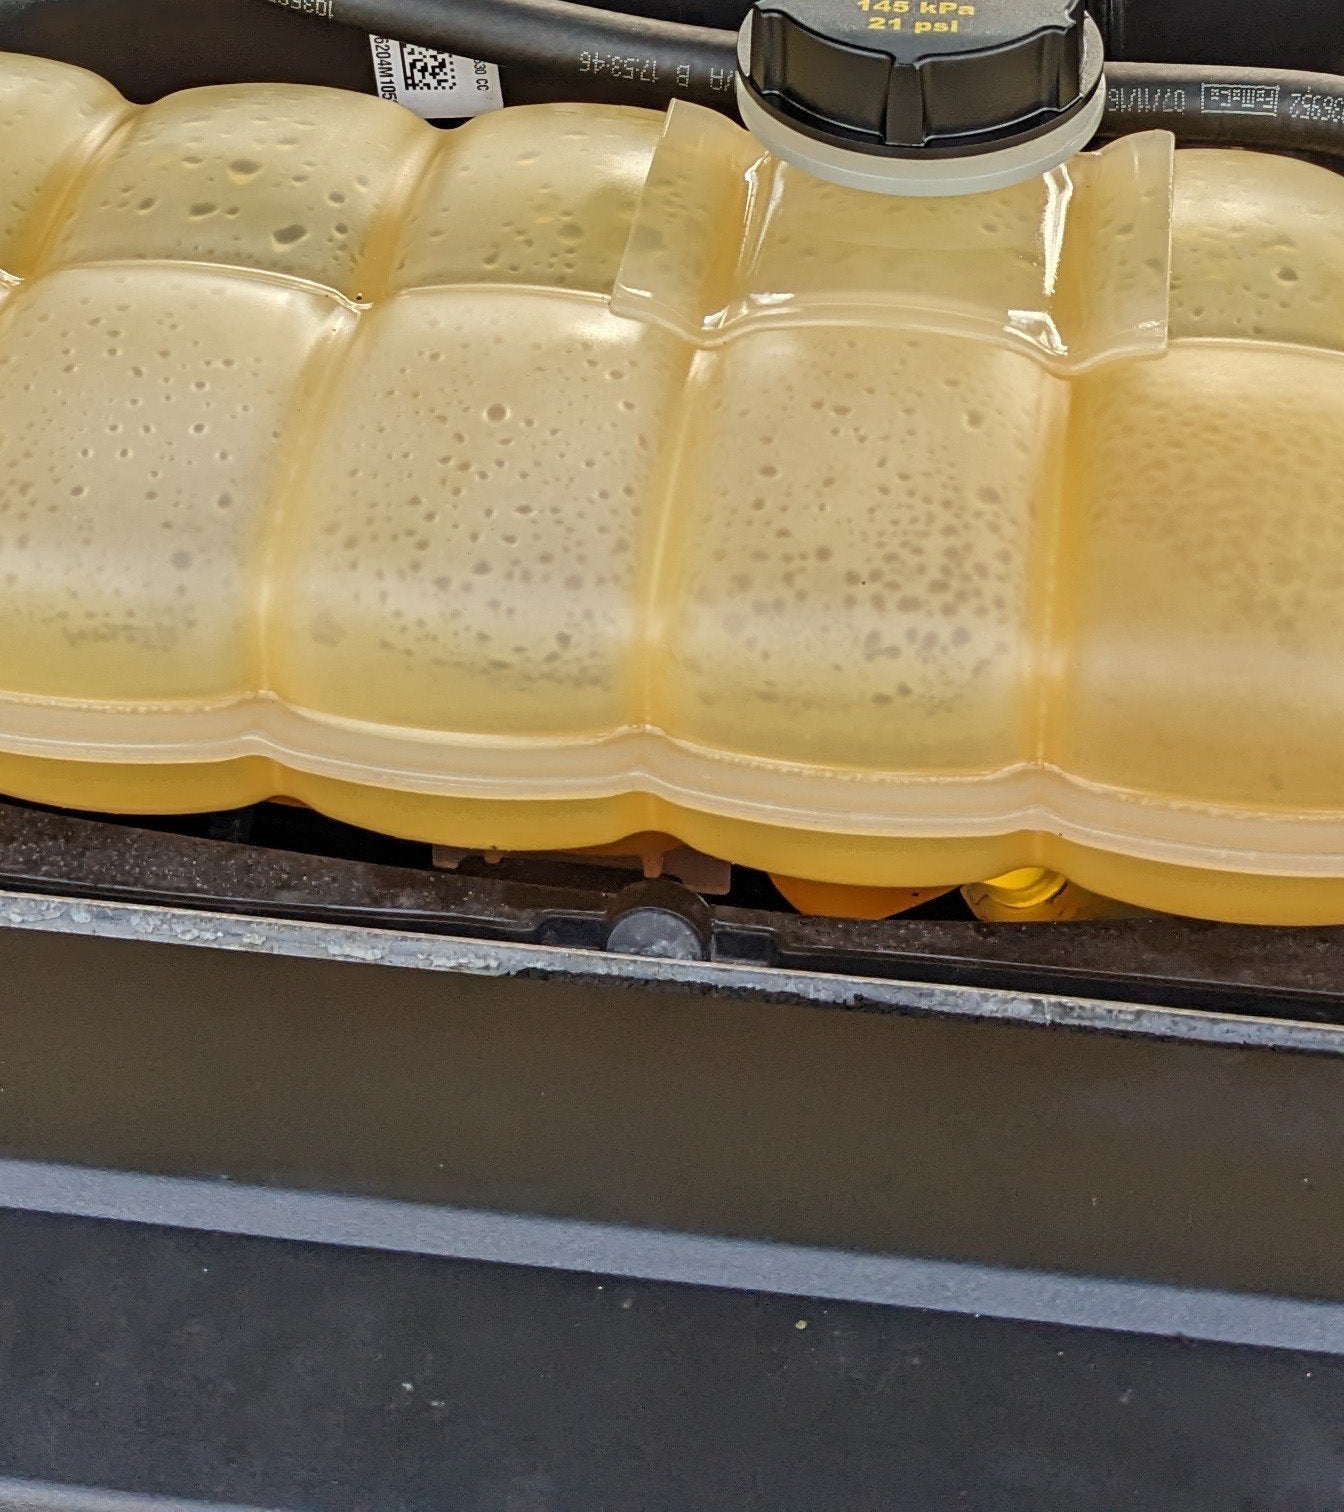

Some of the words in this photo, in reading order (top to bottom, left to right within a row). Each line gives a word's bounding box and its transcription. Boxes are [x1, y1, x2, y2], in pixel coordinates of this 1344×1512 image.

[857, 0, 910, 14] 145
[920, 0, 976, 17] kPa
[867, 17, 901, 31] 21
[914, 18, 959, 34] psi
[372, 35, 398, 103] 6204M105
